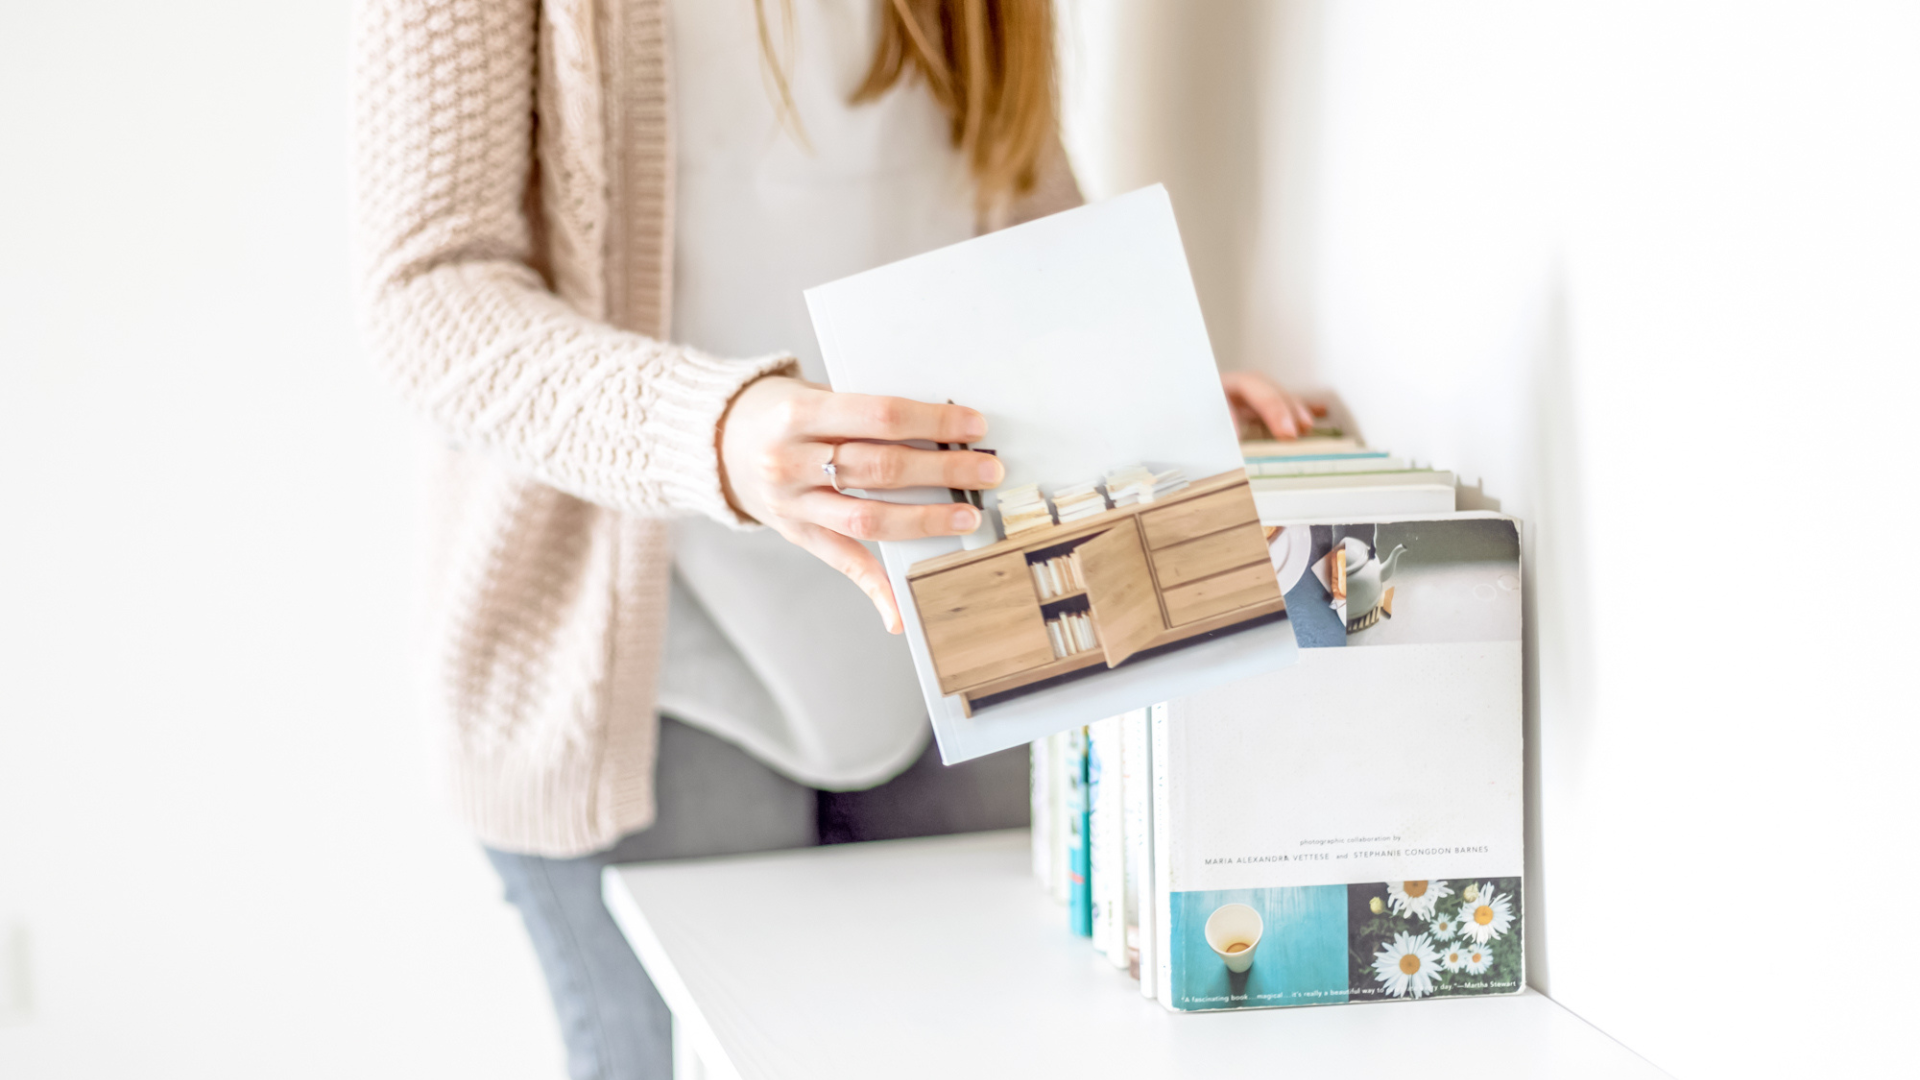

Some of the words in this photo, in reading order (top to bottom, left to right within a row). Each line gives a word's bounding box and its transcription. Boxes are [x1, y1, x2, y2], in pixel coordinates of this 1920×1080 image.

[1299, 837, 1345, 846] photographic
[1346, 835, 1391, 843] collaboration
[1393, 835, 1402, 843] by
[1236, 855, 1290, 864] ALEXANDRA
[1292, 853, 1330, 861] VETTESE
[1353, 849, 1402, 859] STEPHANIE
[1404, 847, 1452, 857] CONGDON
[1454, 845, 1489, 854] BARNES
[1191, 995, 1229, 1004] fascinating
[1303, 989, 1322, 998] really
[1330, 987, 1361, 997] beautiful
[1362, 988, 1375, 996] way
[1490, 980, 1517, 989] Stewart
